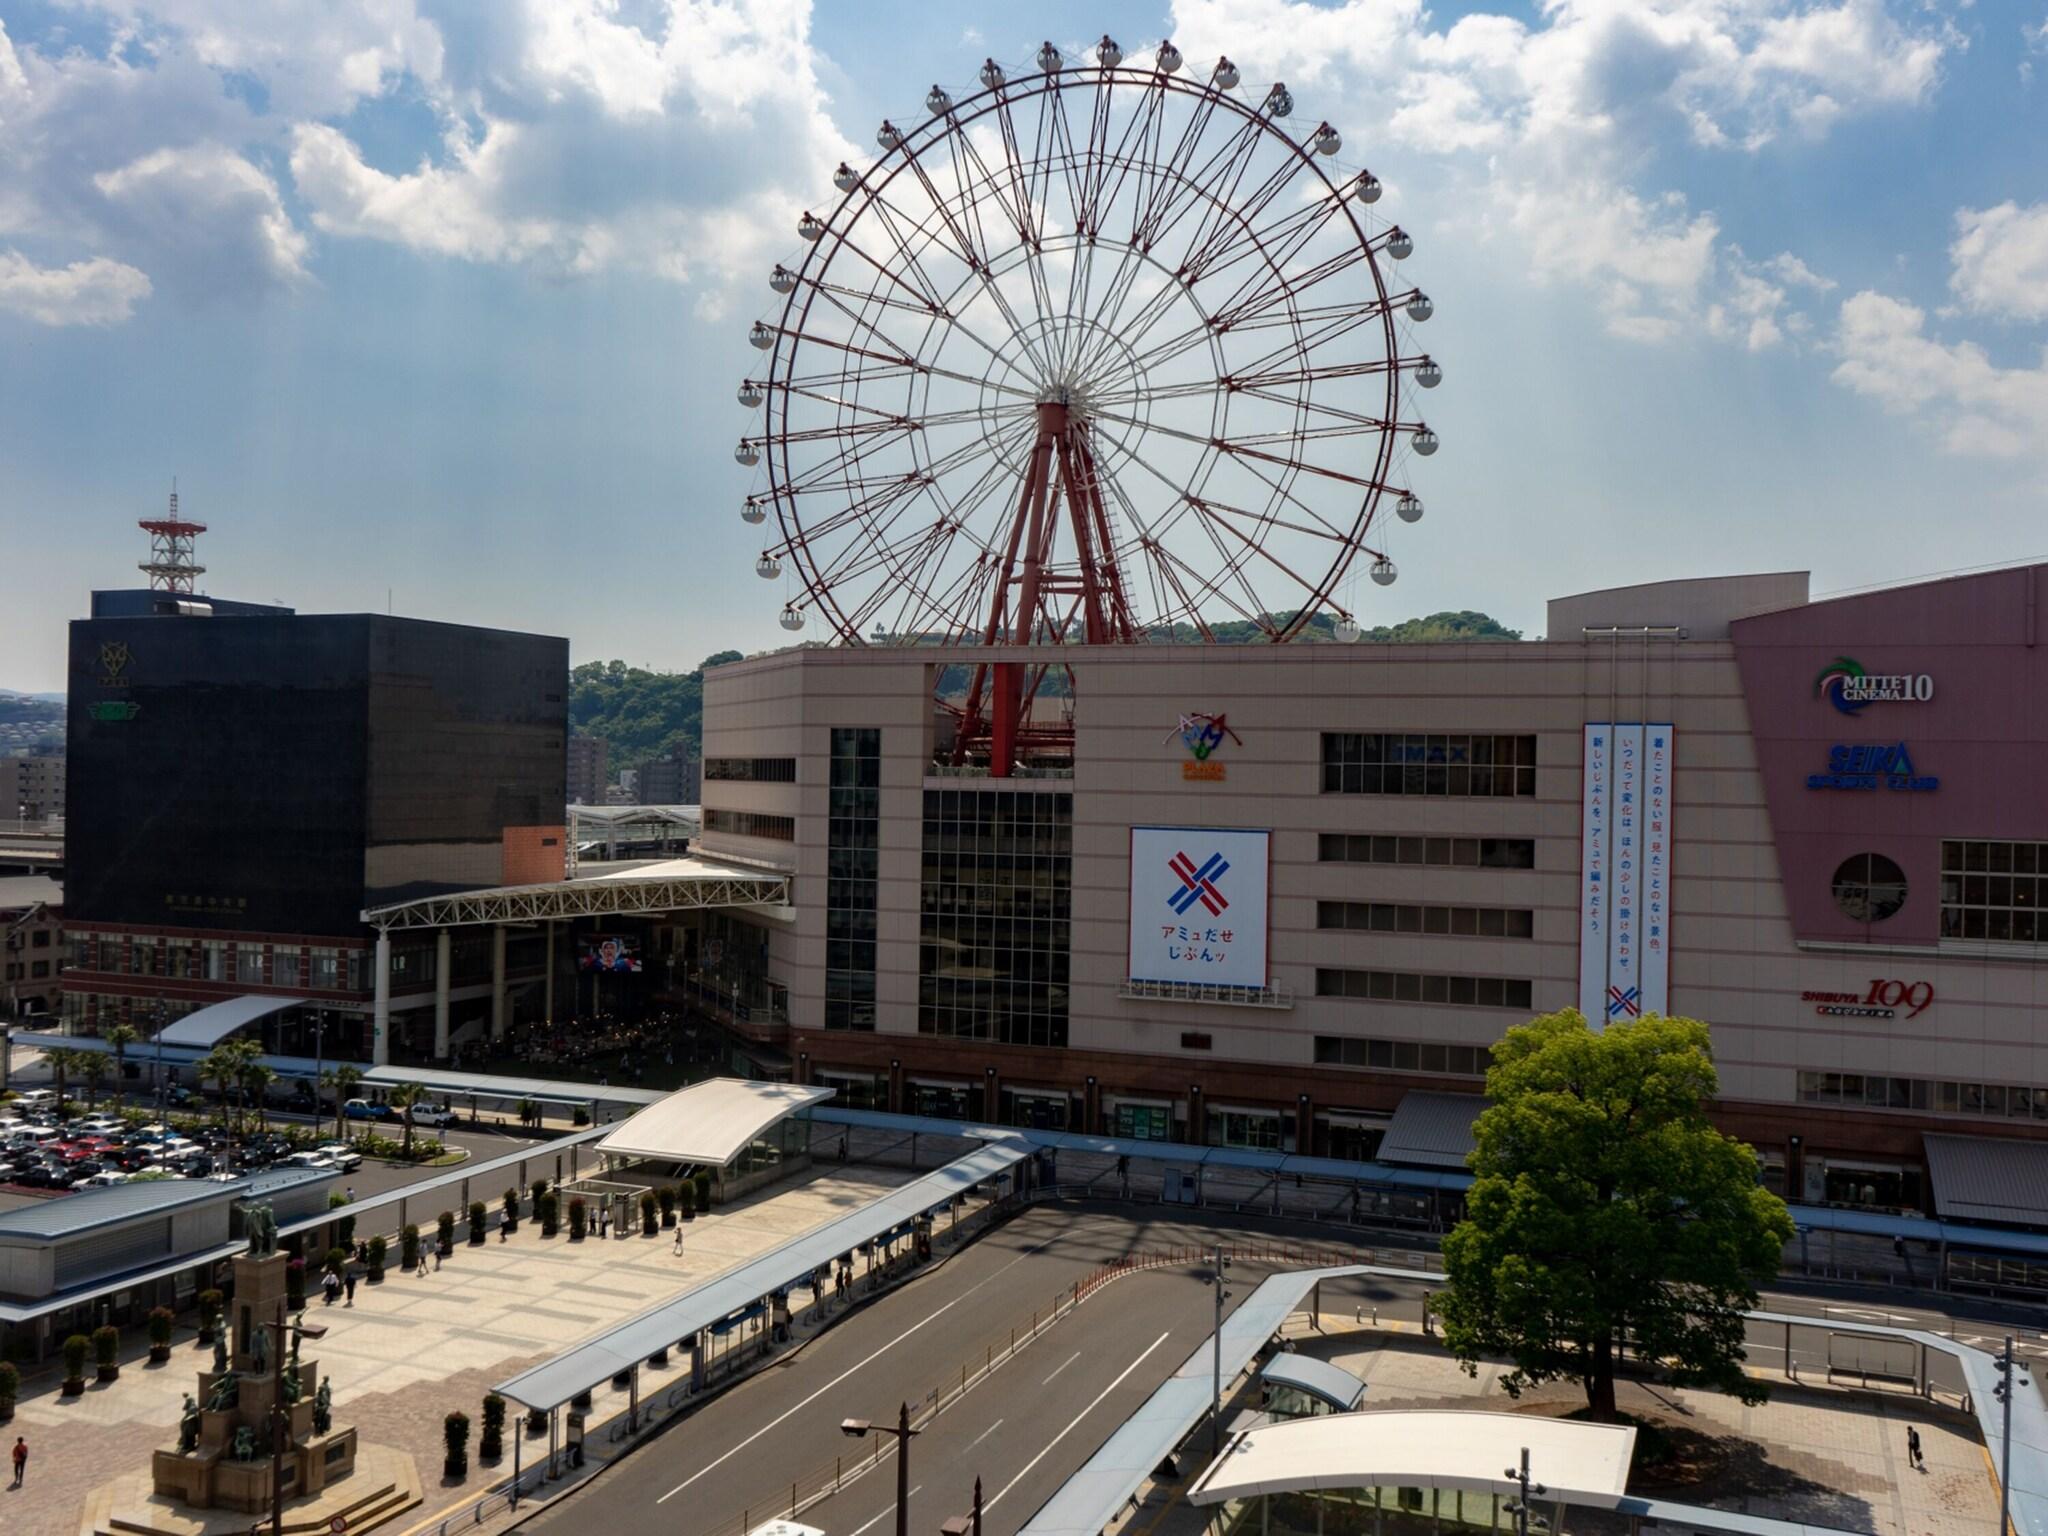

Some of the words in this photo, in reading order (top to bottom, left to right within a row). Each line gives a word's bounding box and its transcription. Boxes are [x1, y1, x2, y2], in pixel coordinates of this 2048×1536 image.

[1843, 676, 1901, 689] MITTE
[1843, 689, 1901, 701] CINEMA
[1901, 675, 1934, 701] 10
[1828, 741, 1914, 774] SEIKA
[1162, 925, 1233, 943] アミュだせ
[1801, 991, 1858, 1004] SHIBUYA
[1862, 979, 1934, 1019] 109
[1817, 1006, 1895, 1018] KAGOSHIMA
